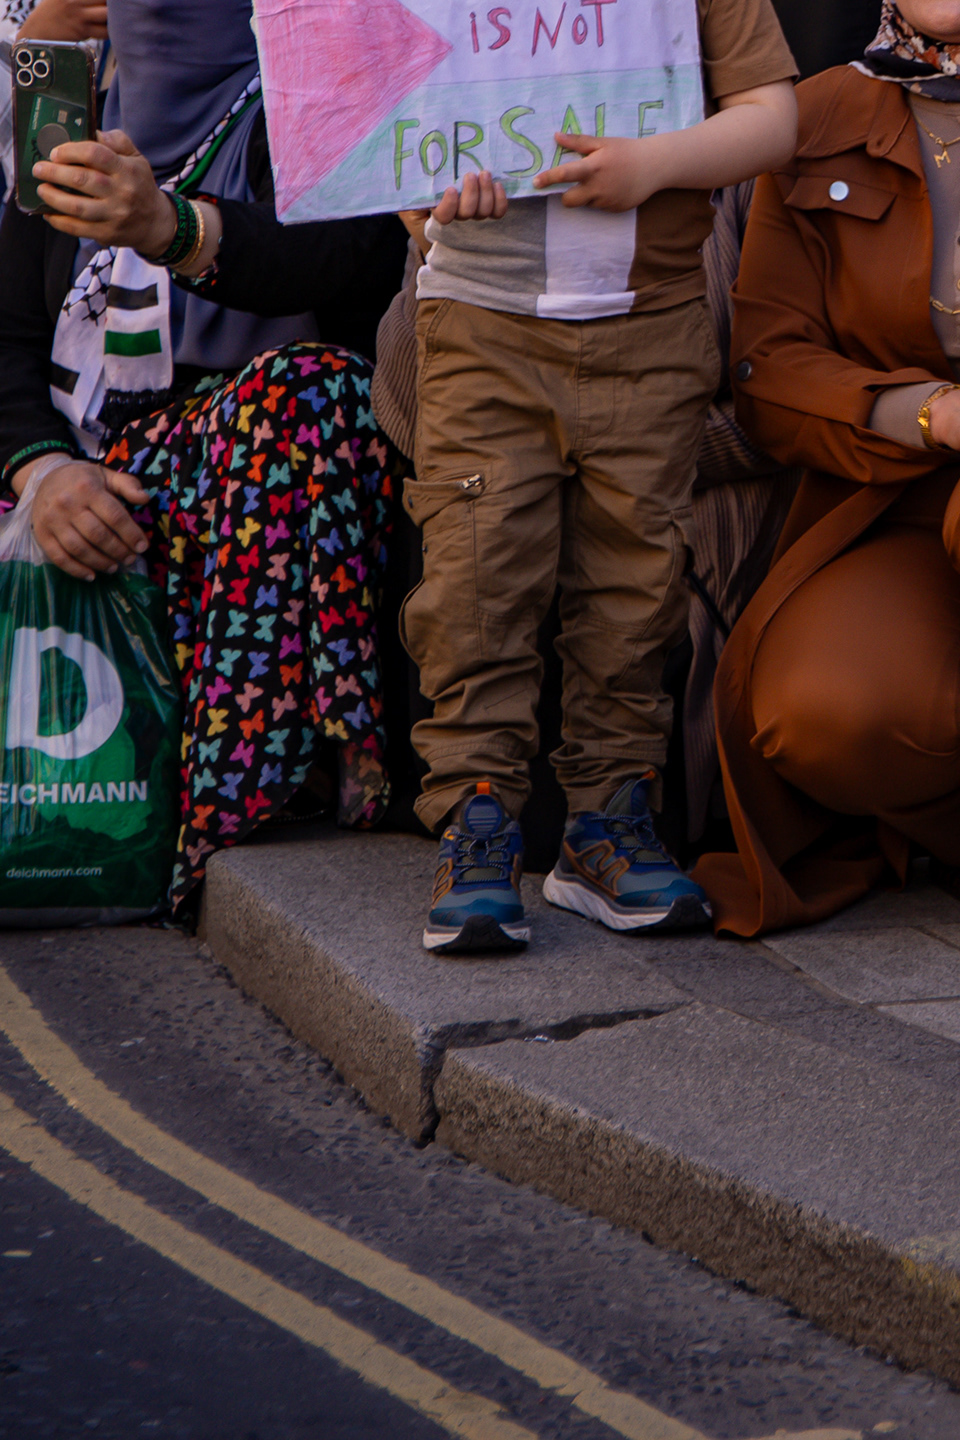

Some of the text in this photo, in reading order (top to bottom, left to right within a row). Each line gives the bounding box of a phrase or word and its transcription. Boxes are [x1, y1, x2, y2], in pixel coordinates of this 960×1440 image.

[393, 119, 485, 192] FOR
[933, 151, 951, 169] M
[6, 625, 124, 760] D
[0, 781, 147, 806] EICHMANN
[6, 867, 103, 878] deichmann.com
